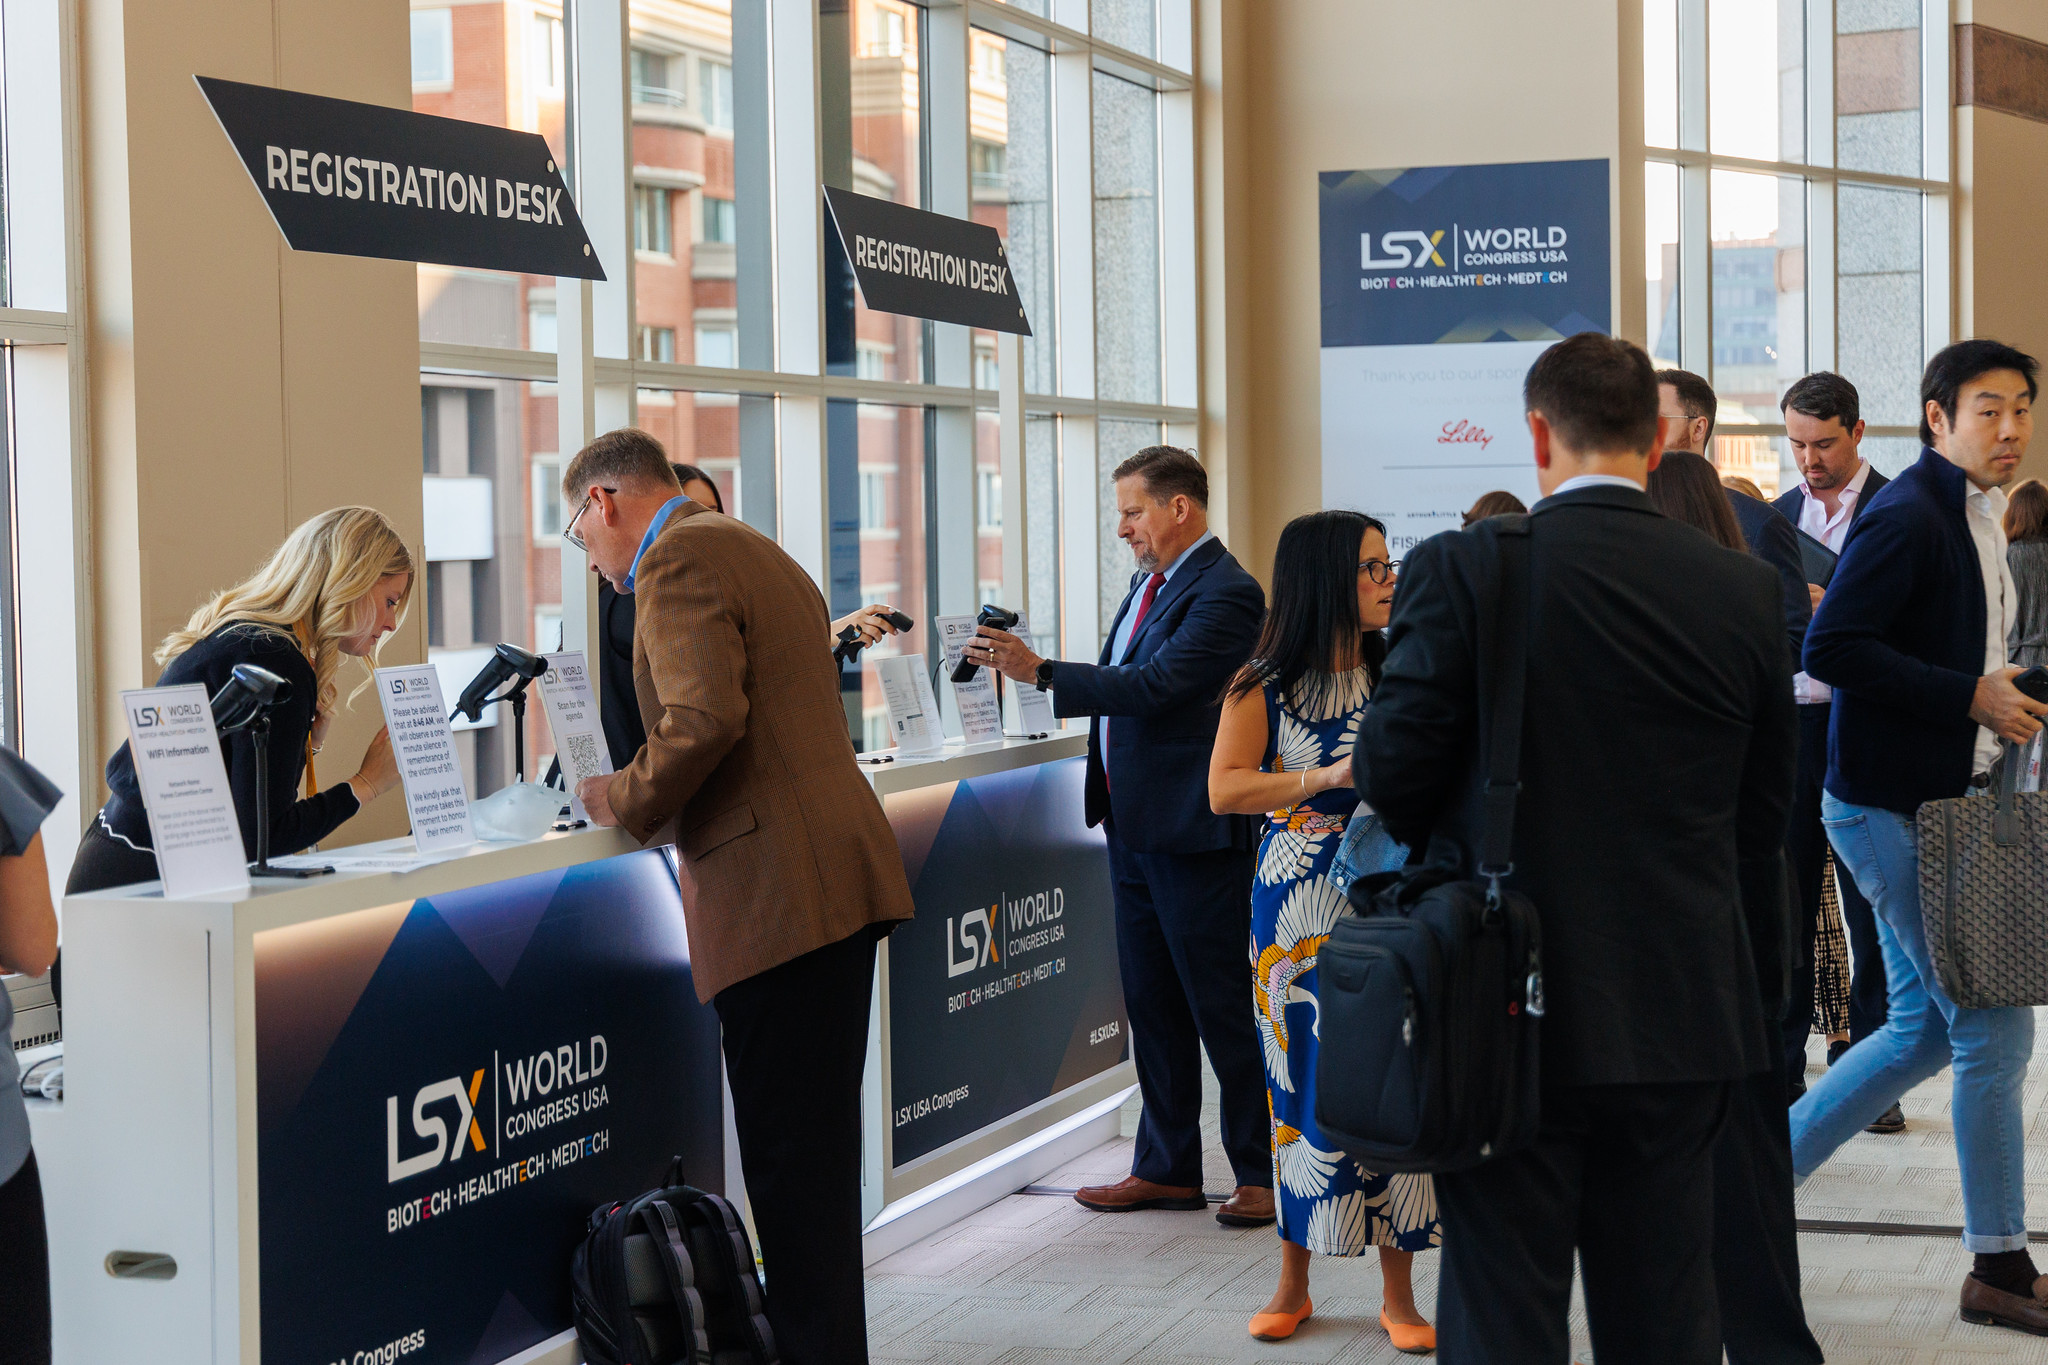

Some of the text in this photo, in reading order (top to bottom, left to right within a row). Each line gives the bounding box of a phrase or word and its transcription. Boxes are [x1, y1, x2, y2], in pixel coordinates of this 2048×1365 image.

[265, 145, 564, 226] REGISTRATION DESK
[1360, 225, 1568, 270] LSX WORLD
[855, 234, 1008, 295] REGISTRATION DESK
[1463, 249, 1568, 266] CONGRESS USA
[1360, 271, 1568, 290] BIOTECH HEALTHTECH MEDTECH
[1361, 368, 1406, 383] Thank
[1407, 370, 1436, 385] you
[1440, 369, 1455, 382] to
[1458, 369, 1483, 381] our
[1437, 418, 1494, 450] Lilly
[561, 665, 582, 676] WORLD
[390, 679, 408, 694] LSX
[408, 677, 429, 687] WORLD
[392, 704, 439, 718] Please be advised
[557, 699, 586, 711] Scan for the
[133, 703, 202, 728] LSX WORLD
[394, 721, 406, 730] that
[406, 720, 412, 729] at
[412, 717, 425, 727] 8:46
[565, 711, 583, 722] agenda
[398, 729, 446, 742] will observe a one-
[166, 743, 210, 758] Information
[403, 739, 448, 754] minute silence in
[406, 750, 450, 766] remembrance of
[408, 768, 418, 779] the
[418, 766, 437, 777] victims
[437, 764, 444, 774] of
[413, 786, 462, 803] We kindly ask that
[415, 798, 465, 816] everyone takes this
[417, 810, 467, 827] moment to honour
[426, 826, 439, 838] their
[946, 887, 1064, 979] LSX WORLD
[1009, 924, 1065, 957] CONGRESS USA
[948, 957, 1066, 1013] BIOTECH HEALTHTECH MEDTECH
[1089, 1020, 1120, 1046] #LSXUSA
[386, 1034, 608, 1184] LSX WORLD
[505, 1084, 609, 1140] CONGRESS USA
[895, 1084, 969, 1128] LSX USA Congress
[387, 1128, 609, 1234] BIOTECH HEALTHTECH MEDTECH
[353, 1328, 425, 1365] Congress
